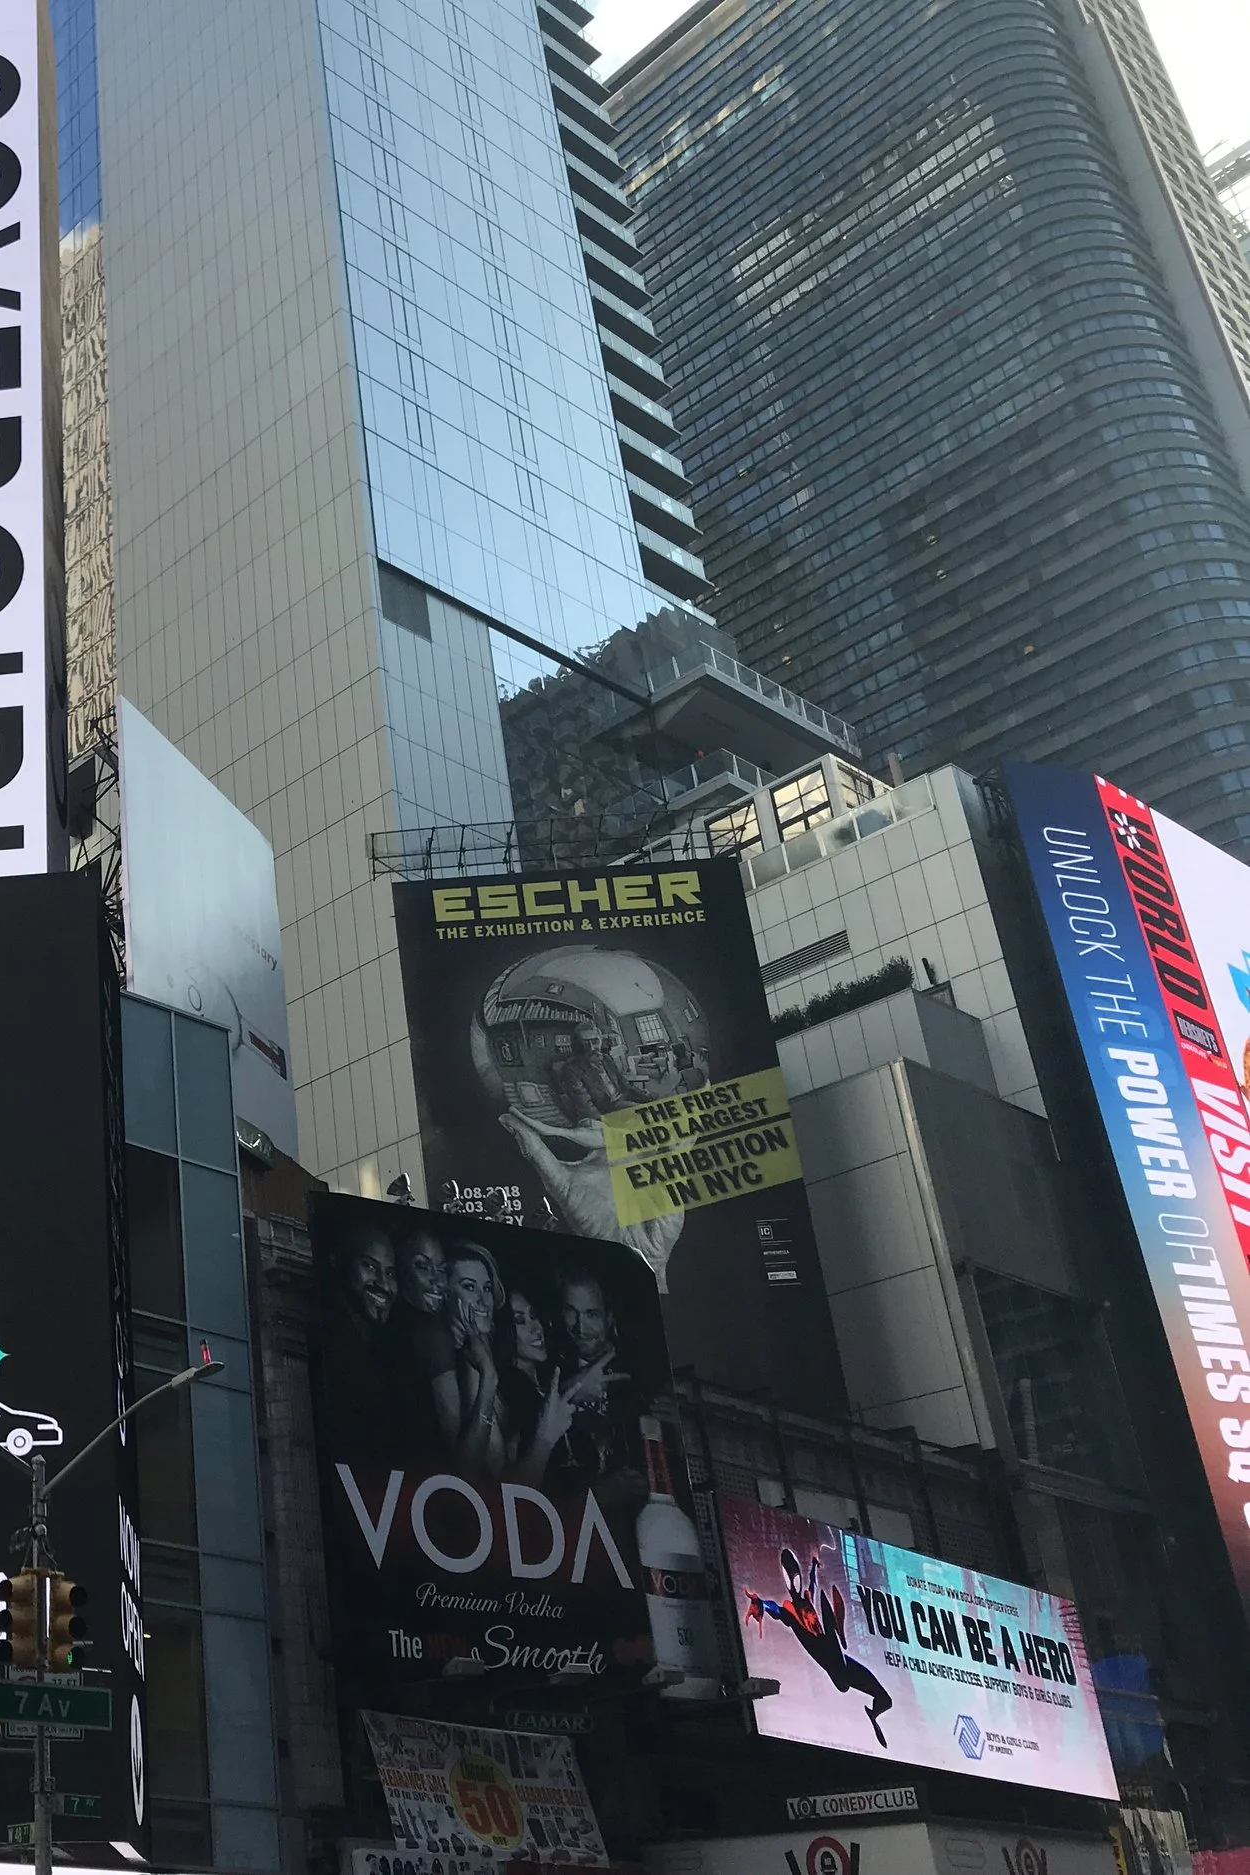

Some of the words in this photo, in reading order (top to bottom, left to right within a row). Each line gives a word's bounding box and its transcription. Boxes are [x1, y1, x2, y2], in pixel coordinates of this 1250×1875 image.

[431, 870, 702, 923] ESCHER
[1043, 826, 1126, 963] UNLOCK
[1108, 806, 1207, 1010] WORLD
[436, 926, 469, 940] THE
[474, 919, 576, 938] EXHIBITION
[581, 917, 594, 931] &
[598, 909, 706, 930] EXPERIENCE
[1085, 973, 1148, 1039] THE
[625, 1125, 671, 1153] AND
[674, 1097, 769, 1146] LARGEST
[635, 1096, 681, 1126] THE
[685, 1082, 743, 1113] FIRST
[1108, 1047, 1197, 1200] POWER
[626, 1127, 790, 1191] EXHIBITION
[1190, 1077, 1250, 1227] VIS
[665, 1179, 702, 1207] IN
[707, 1161, 764, 1200] NYC
[1158, 1212, 1215, 1261] OF
[1172, 1257, 1250, 1404] TIMES
[415, 1581, 501, 1613] Premium
[504, 1590, 566, 1620] Vodka
[388, 1629, 423, 1660] The
[472, 1625, 607, 1675] Smooth
[856, 1584, 910, 1645] YOU
[910, 1600, 963, 1658] CAN
[962, 1614, 999, 1667] BE
[1000, 1625, 1021, 1673] A
[1018, 1630, 1078, 1686] HERO
[14, 1690, 29, 1714] 7
[37, 1693, 71, 1718] AV
[884, 1651, 902, 1665] HELP
[908, 1657, 928, 1674] CHILD
[928, 1662, 954, 1680] ACHIEVE
[983, 1675, 1012, 1694] SUPPORT
[1013, 1683, 1029, 1697] BOYS
[1034, 1687, 1052, 1704] GIRLS
[513, 1713, 586, 1731] LAMAR
[70, 1797, 80, 1813] 7
[456, 1780, 519, 1838] 50
